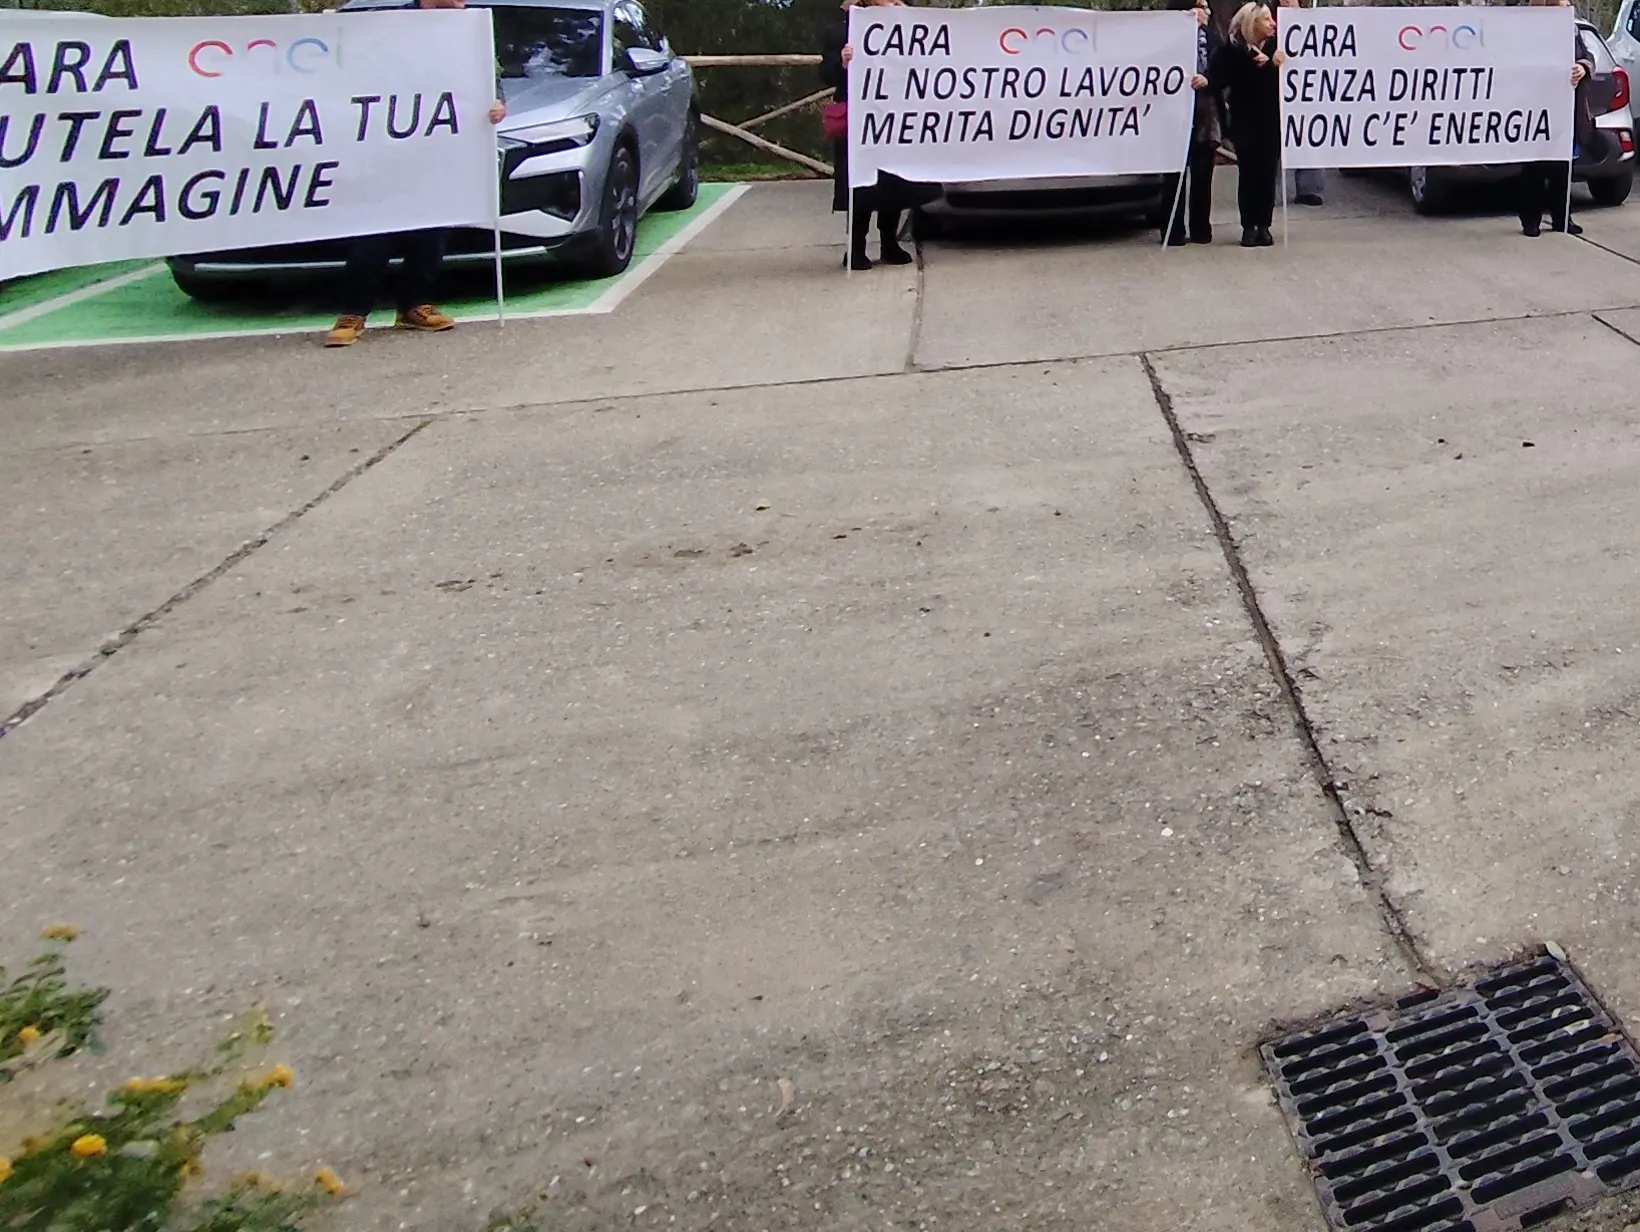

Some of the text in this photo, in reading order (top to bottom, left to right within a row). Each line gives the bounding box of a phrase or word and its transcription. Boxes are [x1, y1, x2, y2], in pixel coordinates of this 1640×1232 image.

[864, 22, 1097, 56] CARA enel
[1285, 19, 1484, 57] CARA enel
[0, 26, 342, 94] ARA enel
[862, 66, 1184, 100] IL NOSTRO LAVORO
[1284, 67, 1493, 102] SENZA DIRITTI
[0, 92, 458, 168] UTELA LA TUA
[861, 104, 1151, 145] MERITA DIGNITA'
[1285, 109, 1550, 147] NON C'E' ENERGIA
[0, 161, 339, 241] MMAGINE
